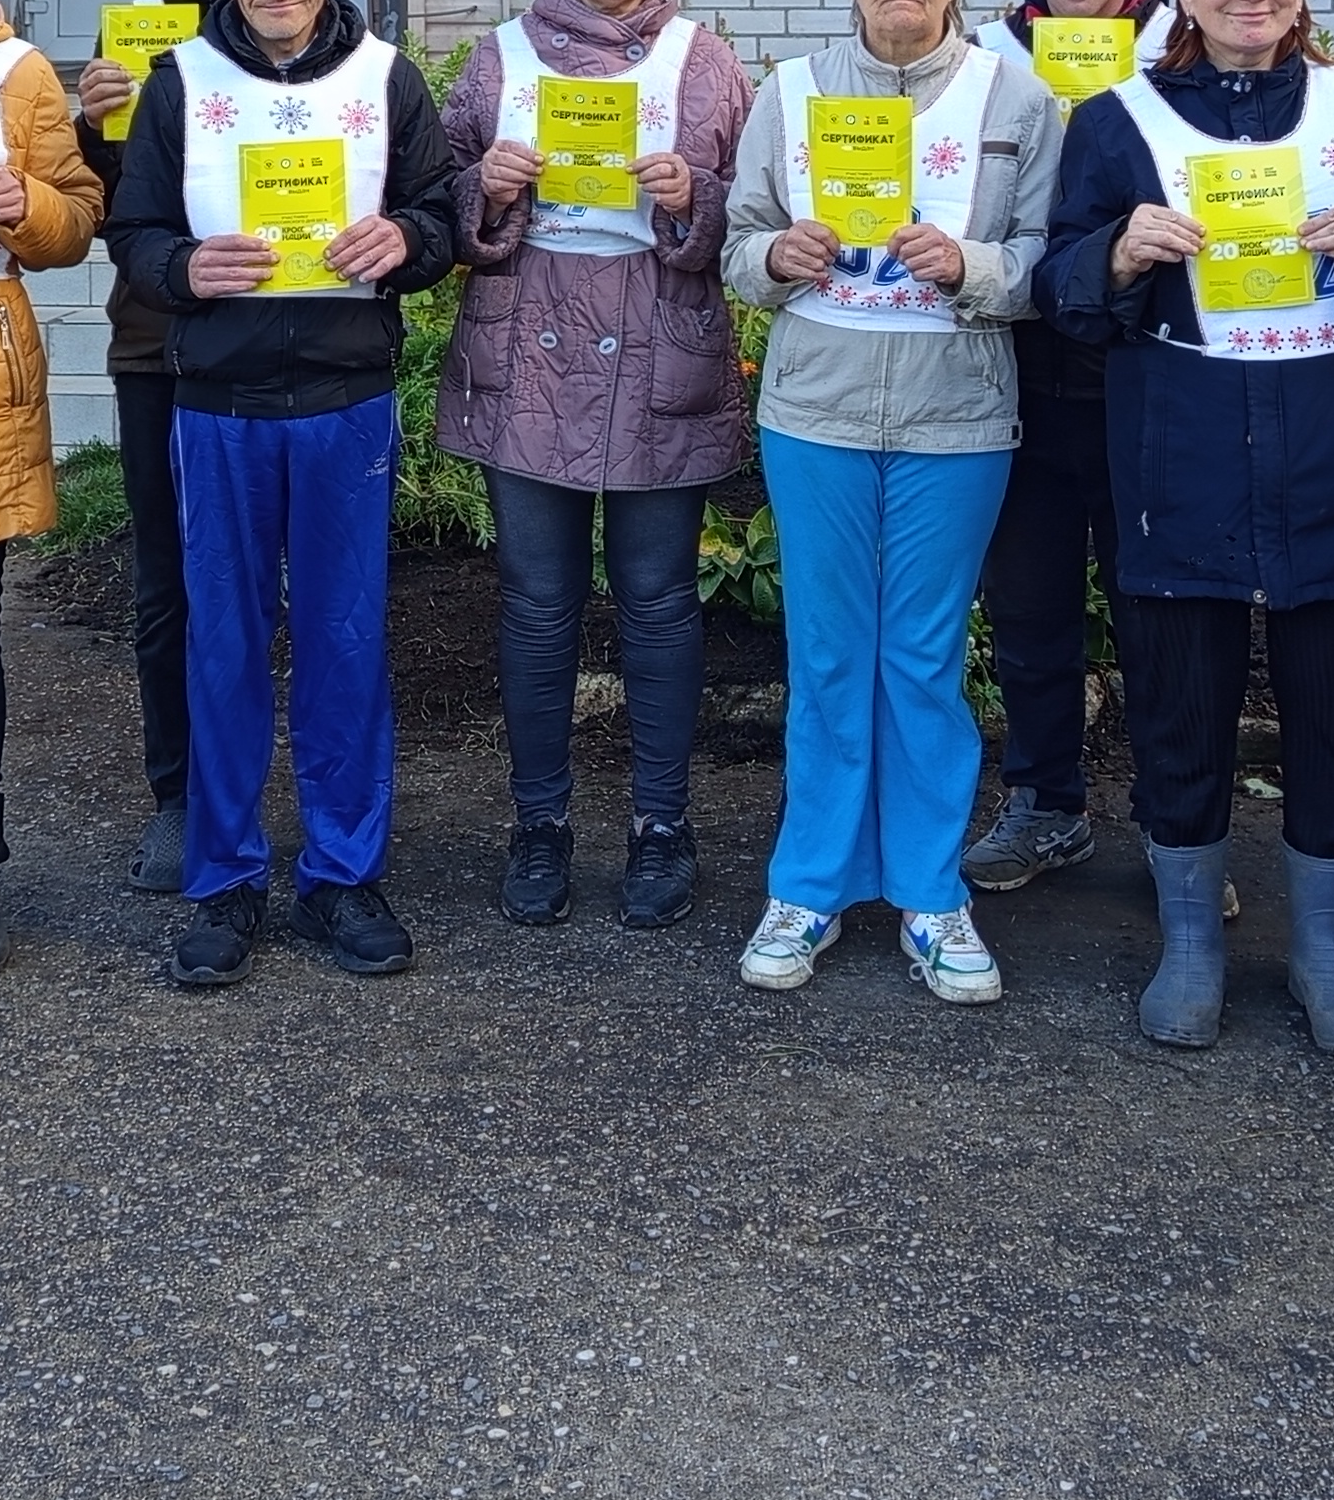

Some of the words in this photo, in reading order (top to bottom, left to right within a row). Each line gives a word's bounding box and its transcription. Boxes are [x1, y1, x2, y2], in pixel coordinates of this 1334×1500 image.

[116, 37, 184, 46] СЕРТИФИКАТ
[1048, 52, 1118, 61] СЕРТИФИКАТ
[551, 110, 621, 121] СЕРТИФИКАТ
[821, 134, 895, 143] СЕРТИФИКАТ
[548, 152, 573, 166] 20
[601, 153, 626, 168] 25
[256, 176, 329, 189] СЕРТИФИКАТ
[821, 179, 845, 197] 20
[875, 181, 900, 198] 25
[1206, 187, 1285, 203] СЕРТИФИКАТ
[255, 226, 281, 243] 20
[282, 233, 310, 241] НАЦИИ
[312, 222, 337, 240] 25
[1209, 242, 1238, 261] 20
[1239, 241, 1262, 249] КРОСС
[1270, 237, 1299, 256] 25
[1239, 249, 1270, 258] НАЦИИ
